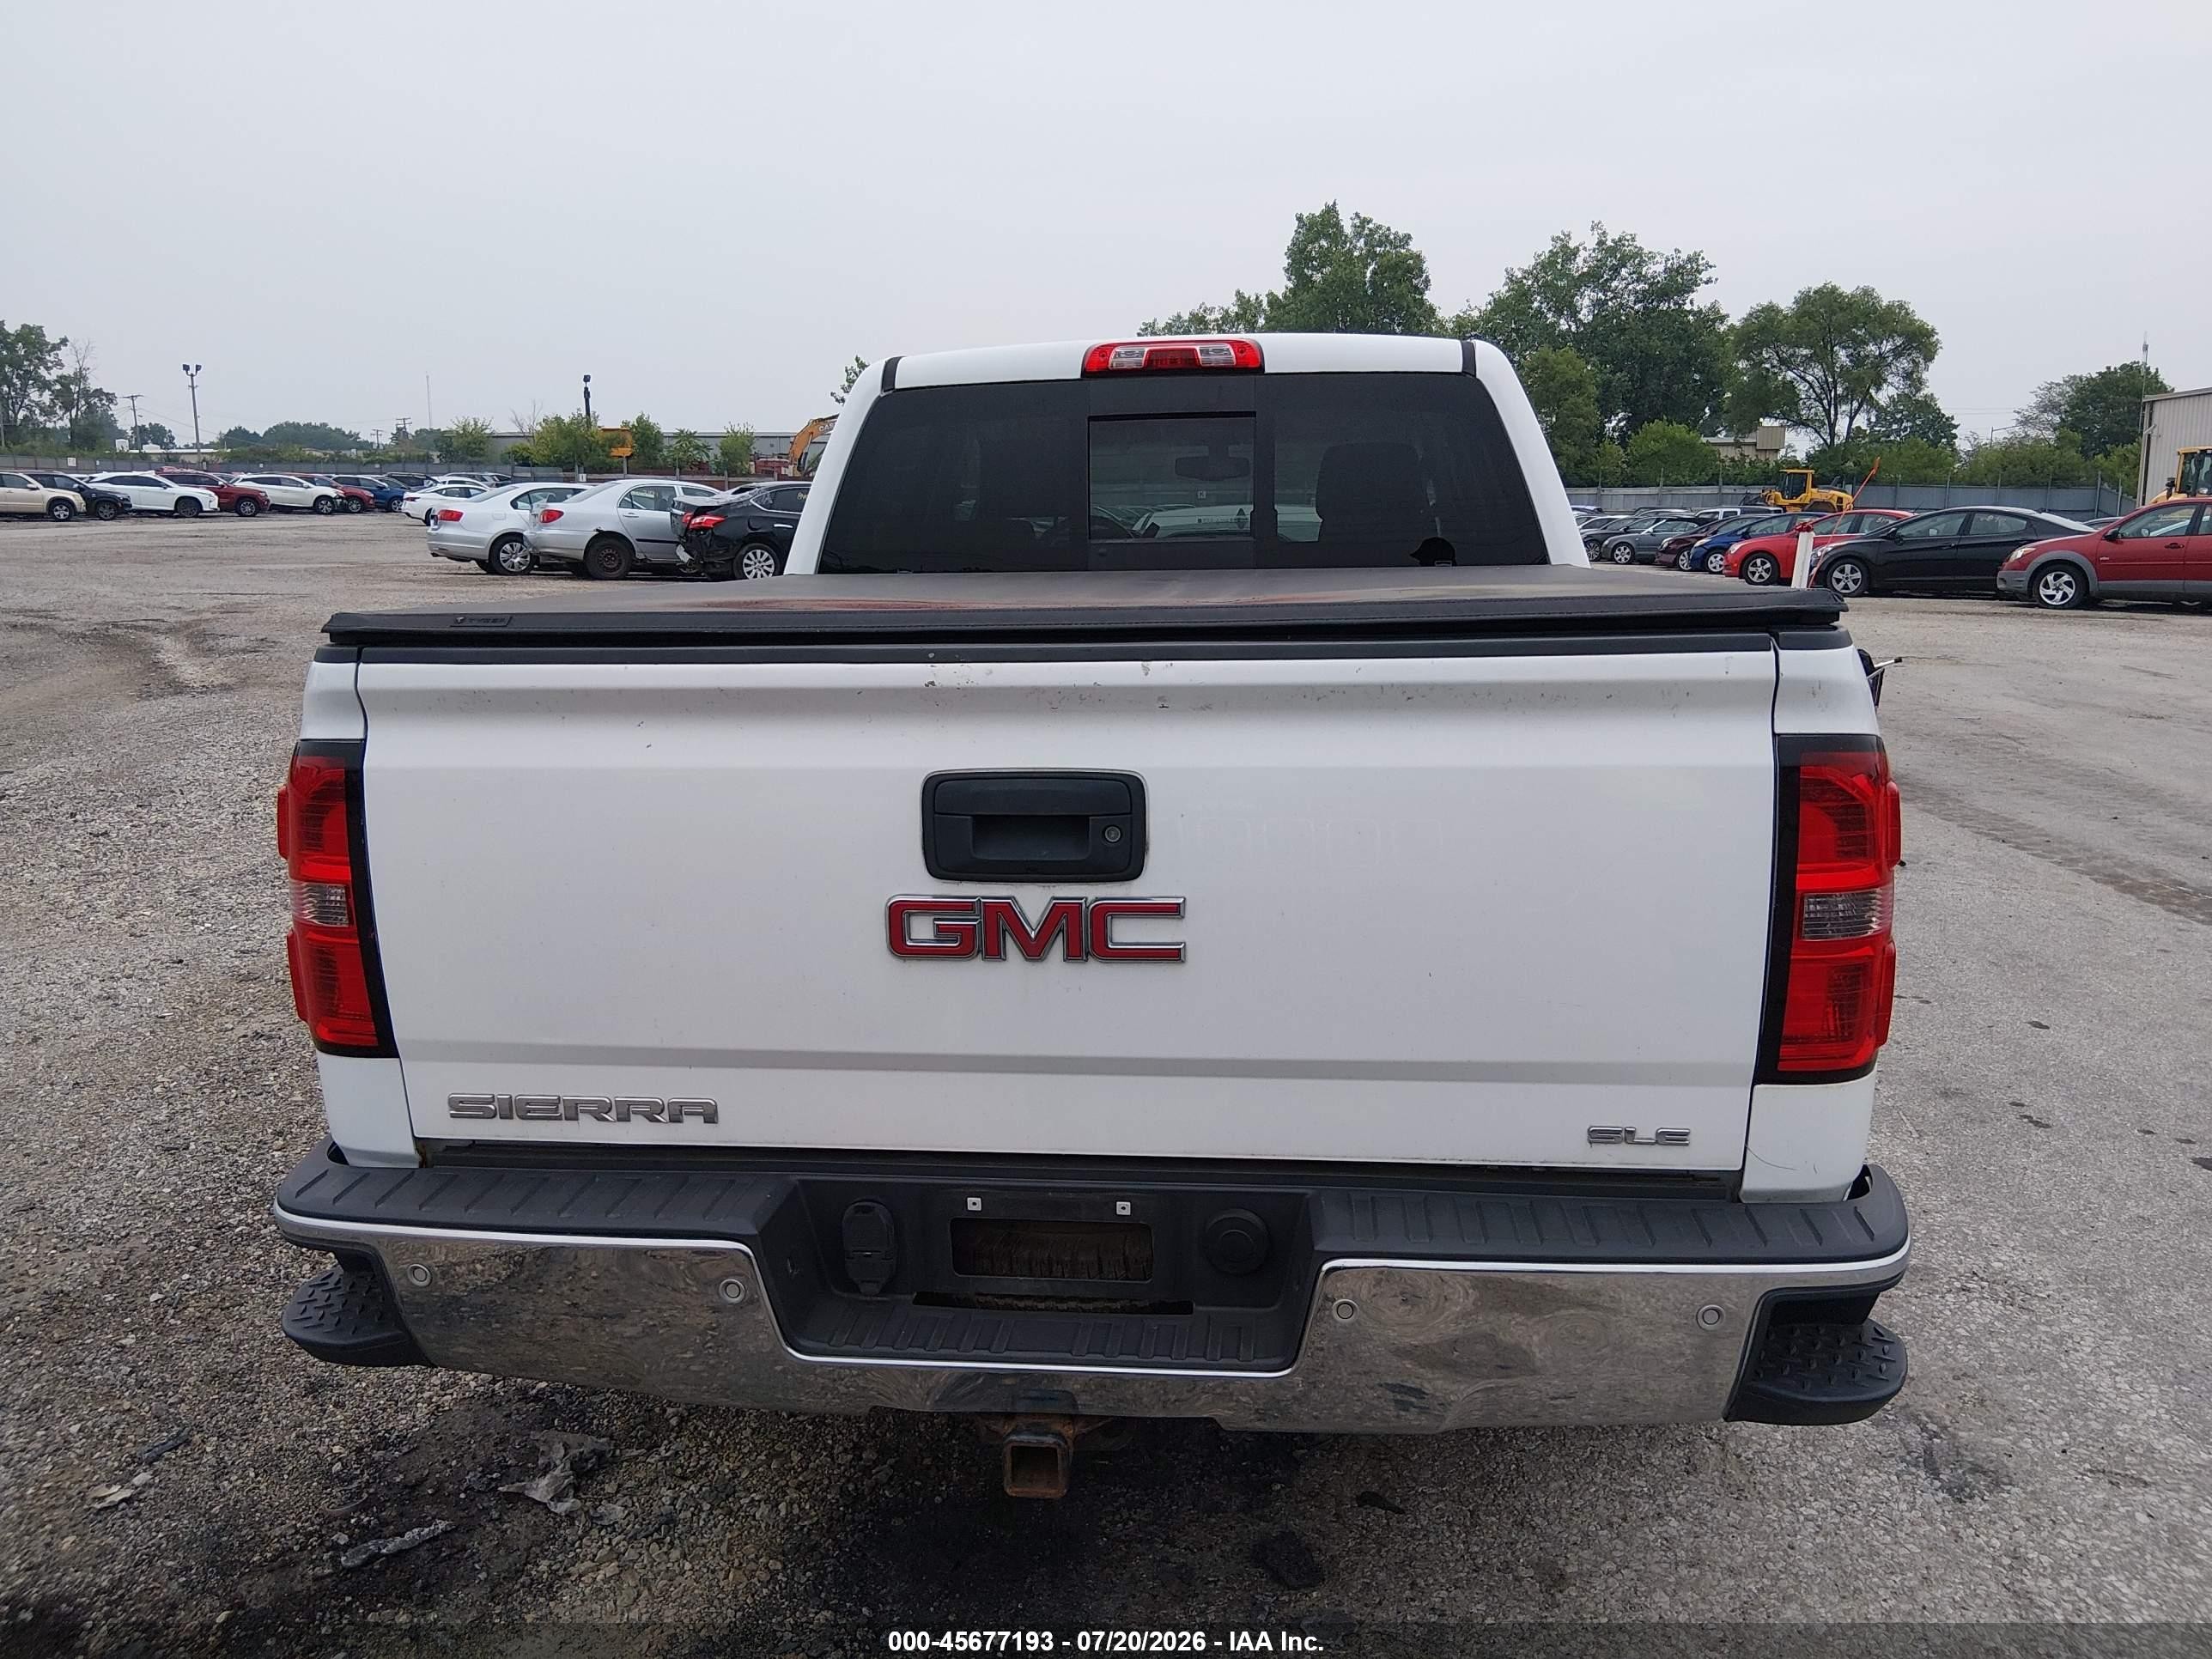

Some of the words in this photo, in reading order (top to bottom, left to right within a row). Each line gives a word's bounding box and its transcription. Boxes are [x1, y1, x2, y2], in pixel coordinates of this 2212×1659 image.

[886, 894, 1186, 963] GMC
[448, 1093, 718, 1123] SIERRA
[1588, 1127, 1690, 1146] SLE
